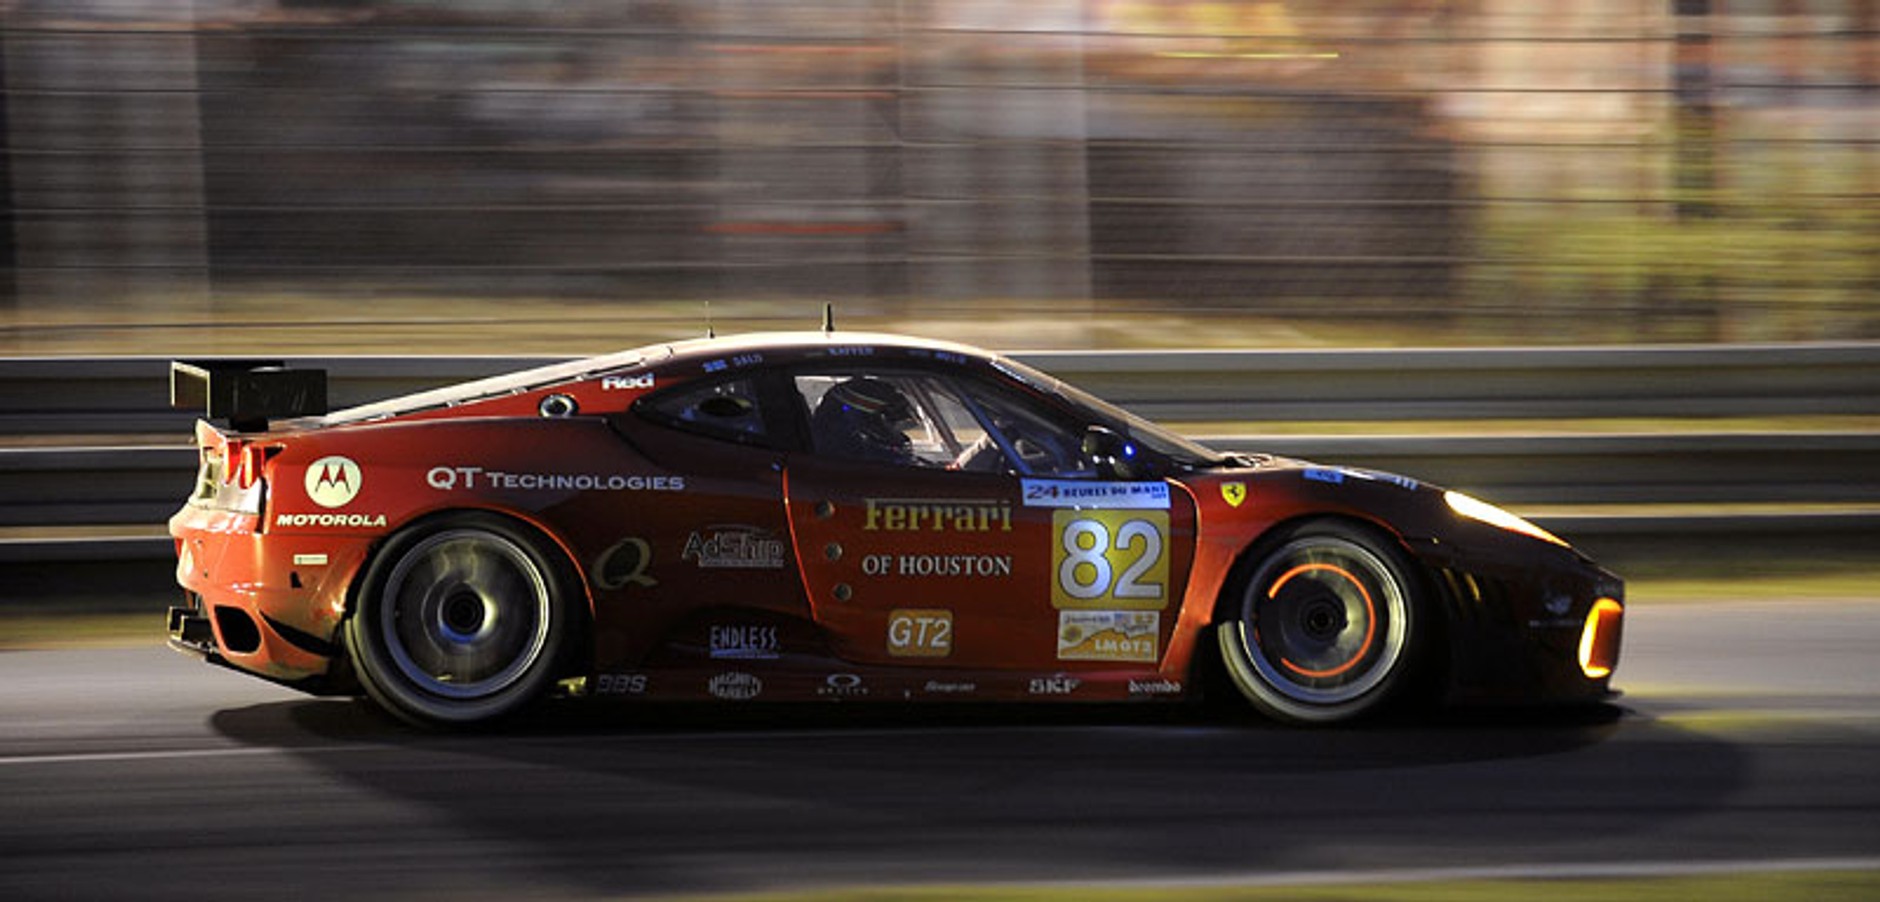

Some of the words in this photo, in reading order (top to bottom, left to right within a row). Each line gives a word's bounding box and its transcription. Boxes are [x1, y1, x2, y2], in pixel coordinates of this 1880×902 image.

[426, 467, 483, 489] QT
[486, 472, 686, 491] TECHNOLOGIES
[1026, 484, 1060, 500] 24
[1112, 486, 1127, 496] DU
[276, 514, 387, 527] MOTOROLA
[864, 498, 1012, 531] Ferrari
[862, 555, 892, 575] OF
[900, 555, 1012, 576] HOUSTON
[1058, 519, 1164, 599] 82
[710, 626, 778, 649] ENDLESS
[889, 617, 951, 648] GT2
